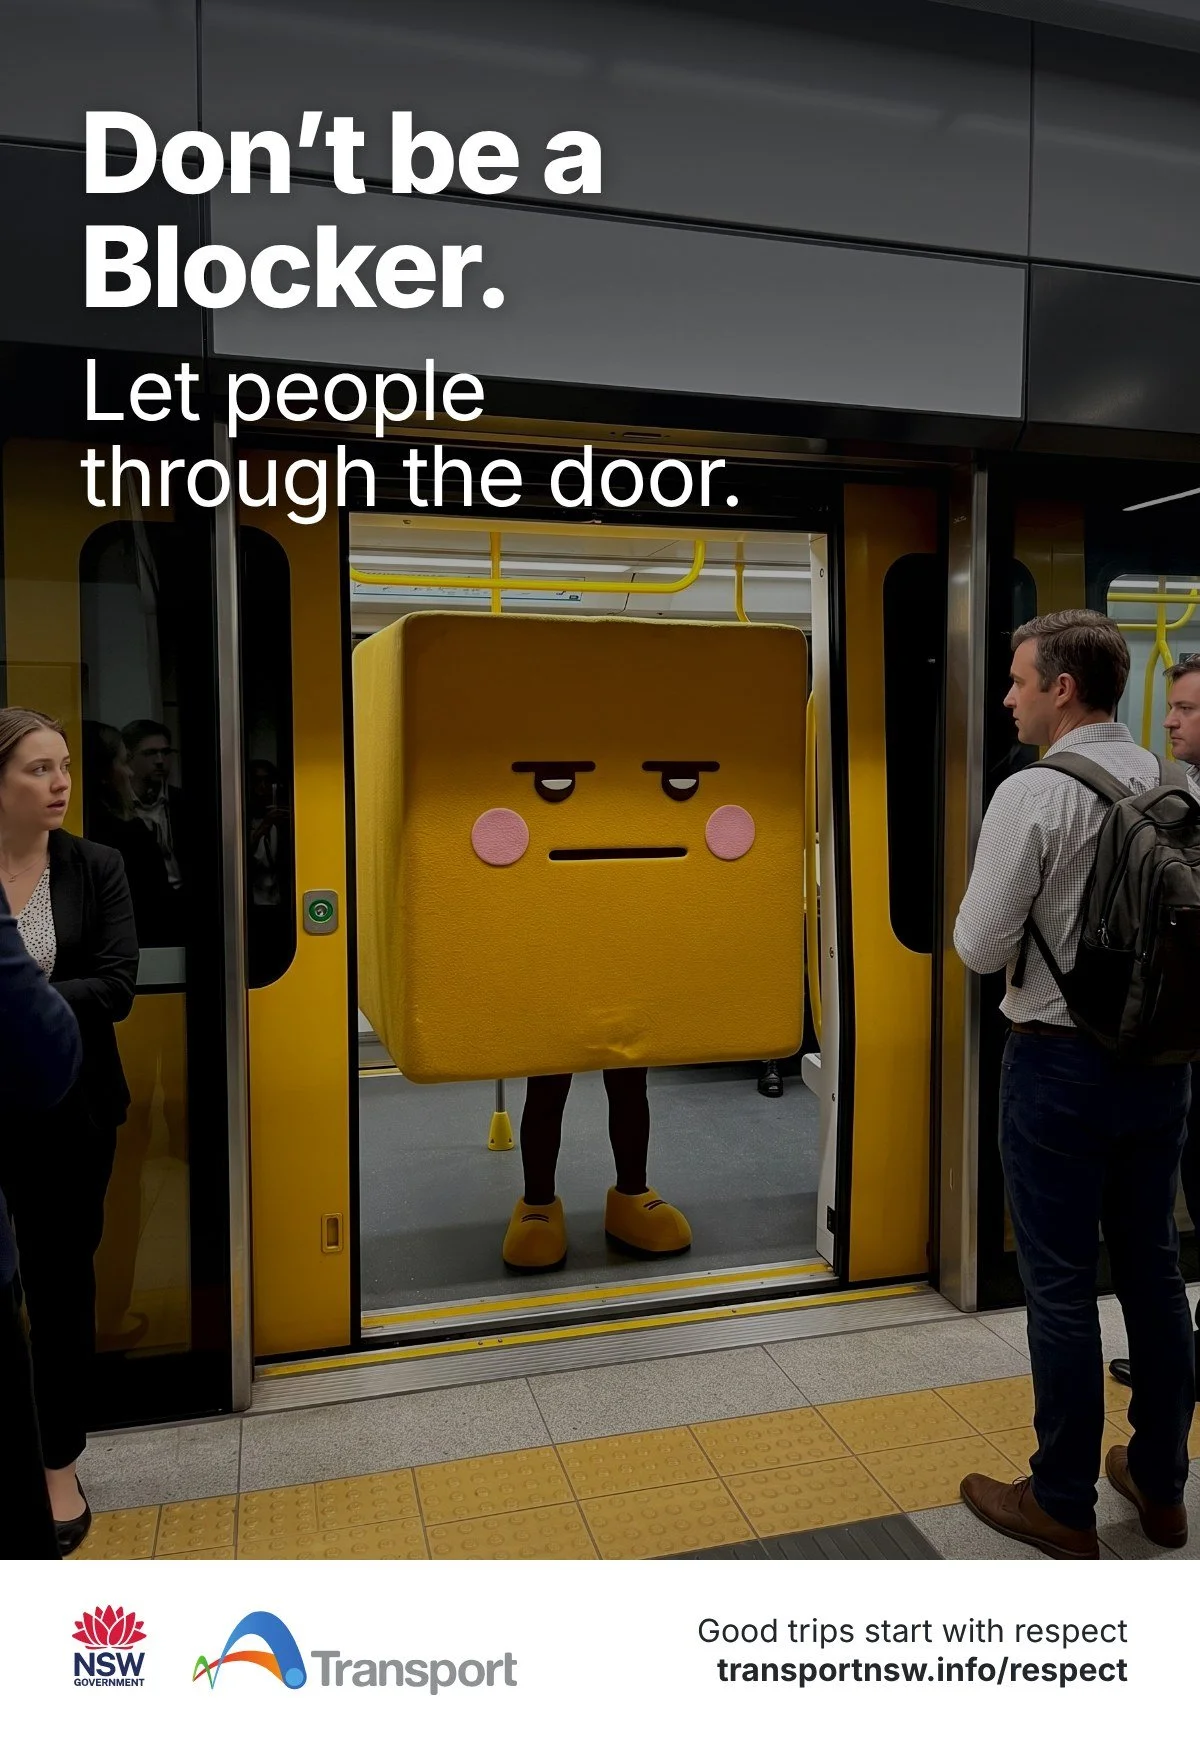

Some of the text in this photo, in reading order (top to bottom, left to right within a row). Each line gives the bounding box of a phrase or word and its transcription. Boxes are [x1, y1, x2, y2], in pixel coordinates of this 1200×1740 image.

[86, 111, 602, 194] Don’t be a
[86, 225, 504, 308] Blocker.
[86, 359, 484, 437] Let people
[81, 445, 739, 524] through the door.
[698, 1618, 1127, 1649] Good trips start with respect
[74, 1652, 145, 1677] NSW
[74, 1678, 145, 1687] GOVERNMENT
[311, 1651, 517, 1695] Transport
[717, 1656, 1127, 1688] transportnsw.info/respect
